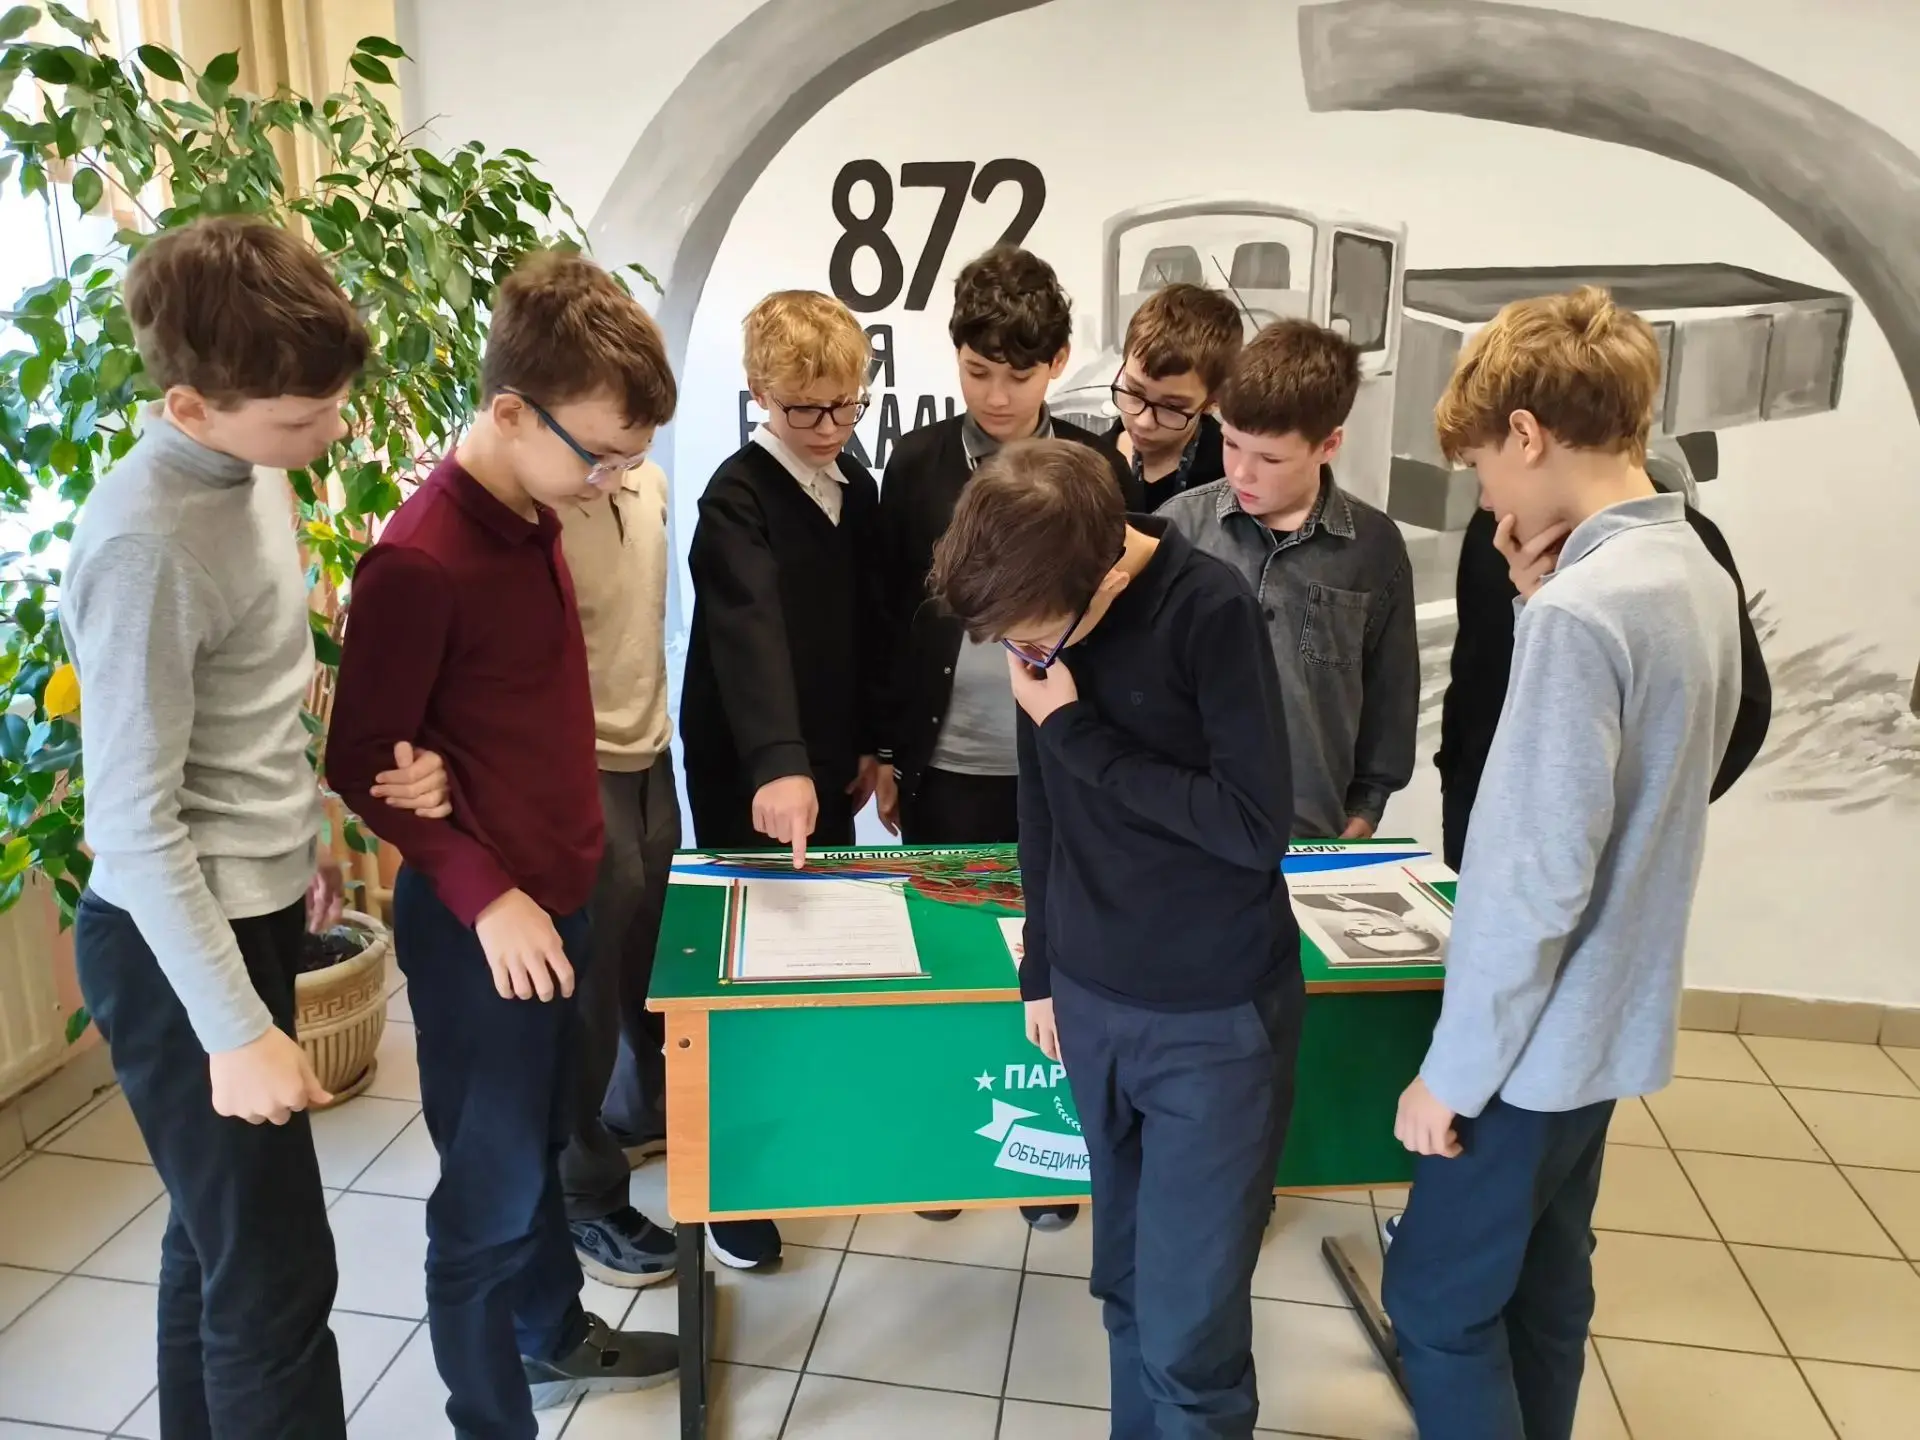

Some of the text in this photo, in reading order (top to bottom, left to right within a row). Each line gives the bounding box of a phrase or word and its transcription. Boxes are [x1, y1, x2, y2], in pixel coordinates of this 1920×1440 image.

[829, 158, 1046, 313] 872
[1004, 1064, 1067, 1090] ПАР
[1008, 1142, 1091, 1171] ОБЪЕДИНЯ
